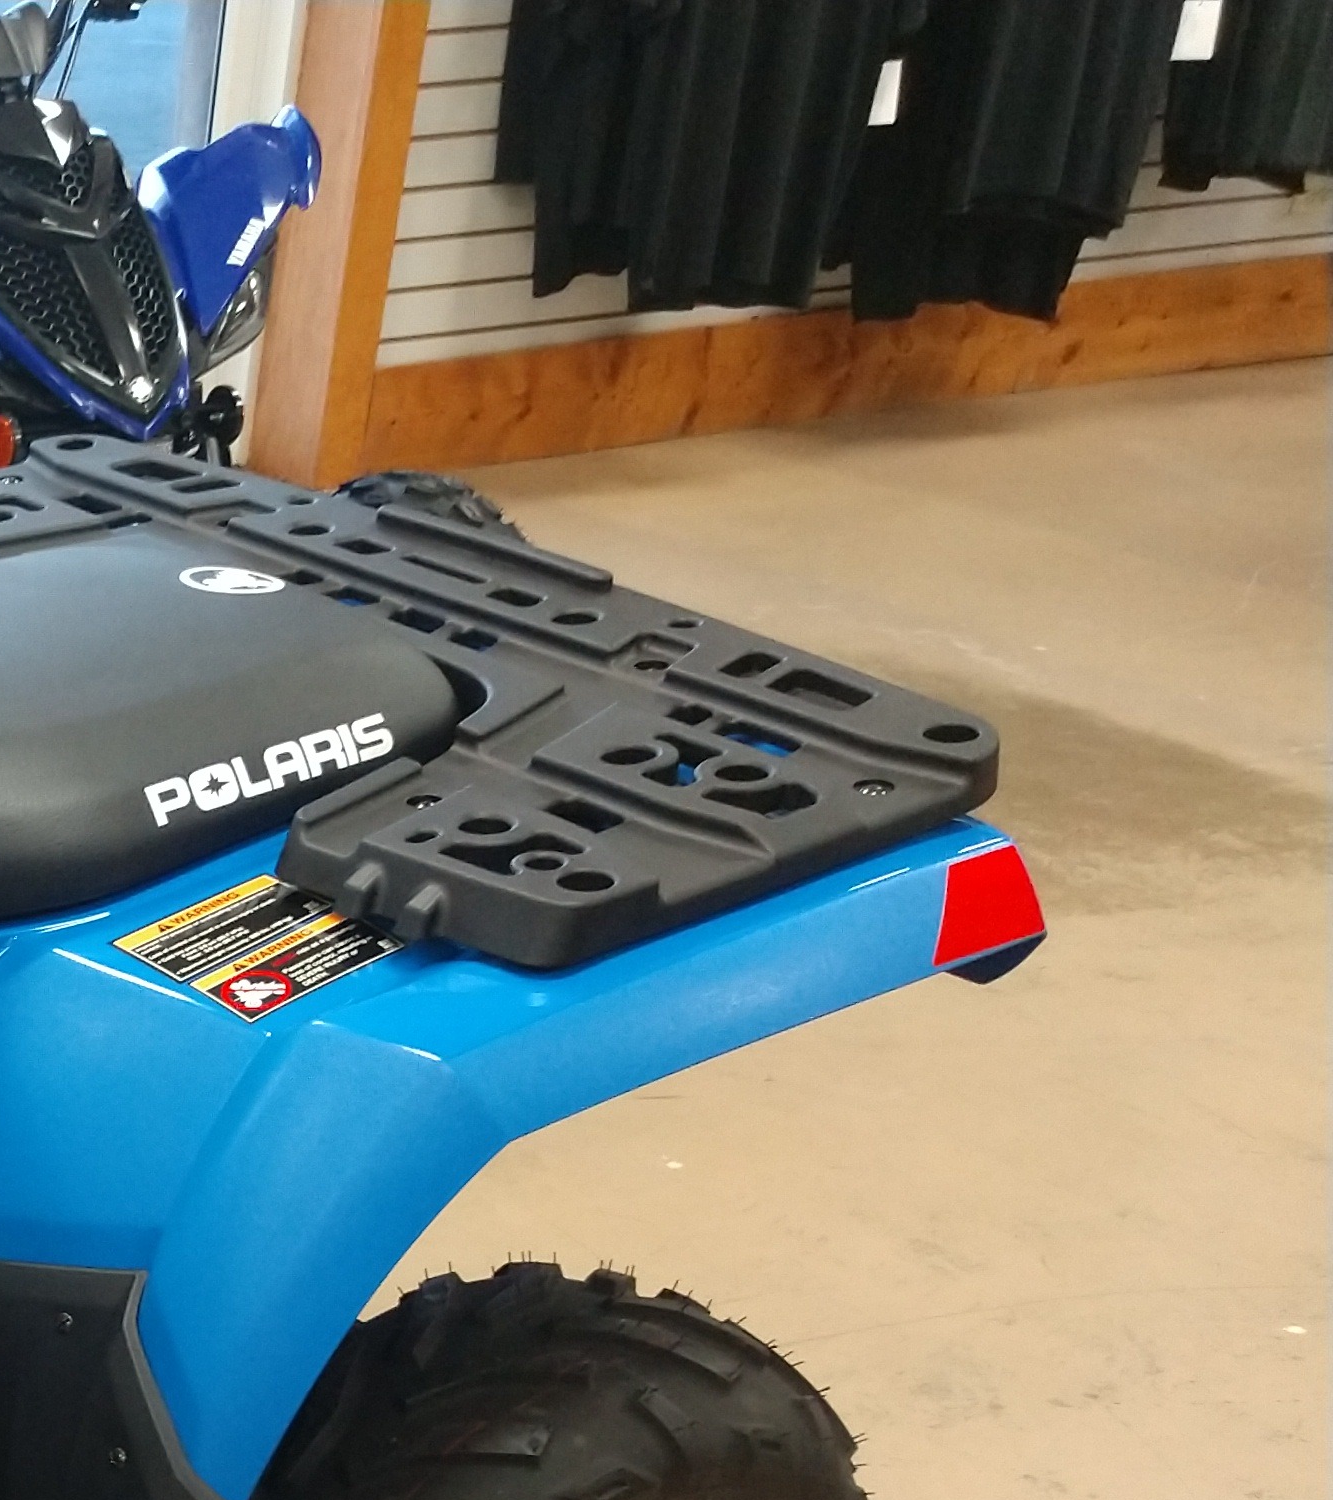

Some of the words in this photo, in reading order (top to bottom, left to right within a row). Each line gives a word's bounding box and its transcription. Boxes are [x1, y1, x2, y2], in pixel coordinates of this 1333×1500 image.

[143, 712, 394, 828] POLARIS
[169, 891, 241, 927] WARNING
[244, 928, 314, 965] WARNING
